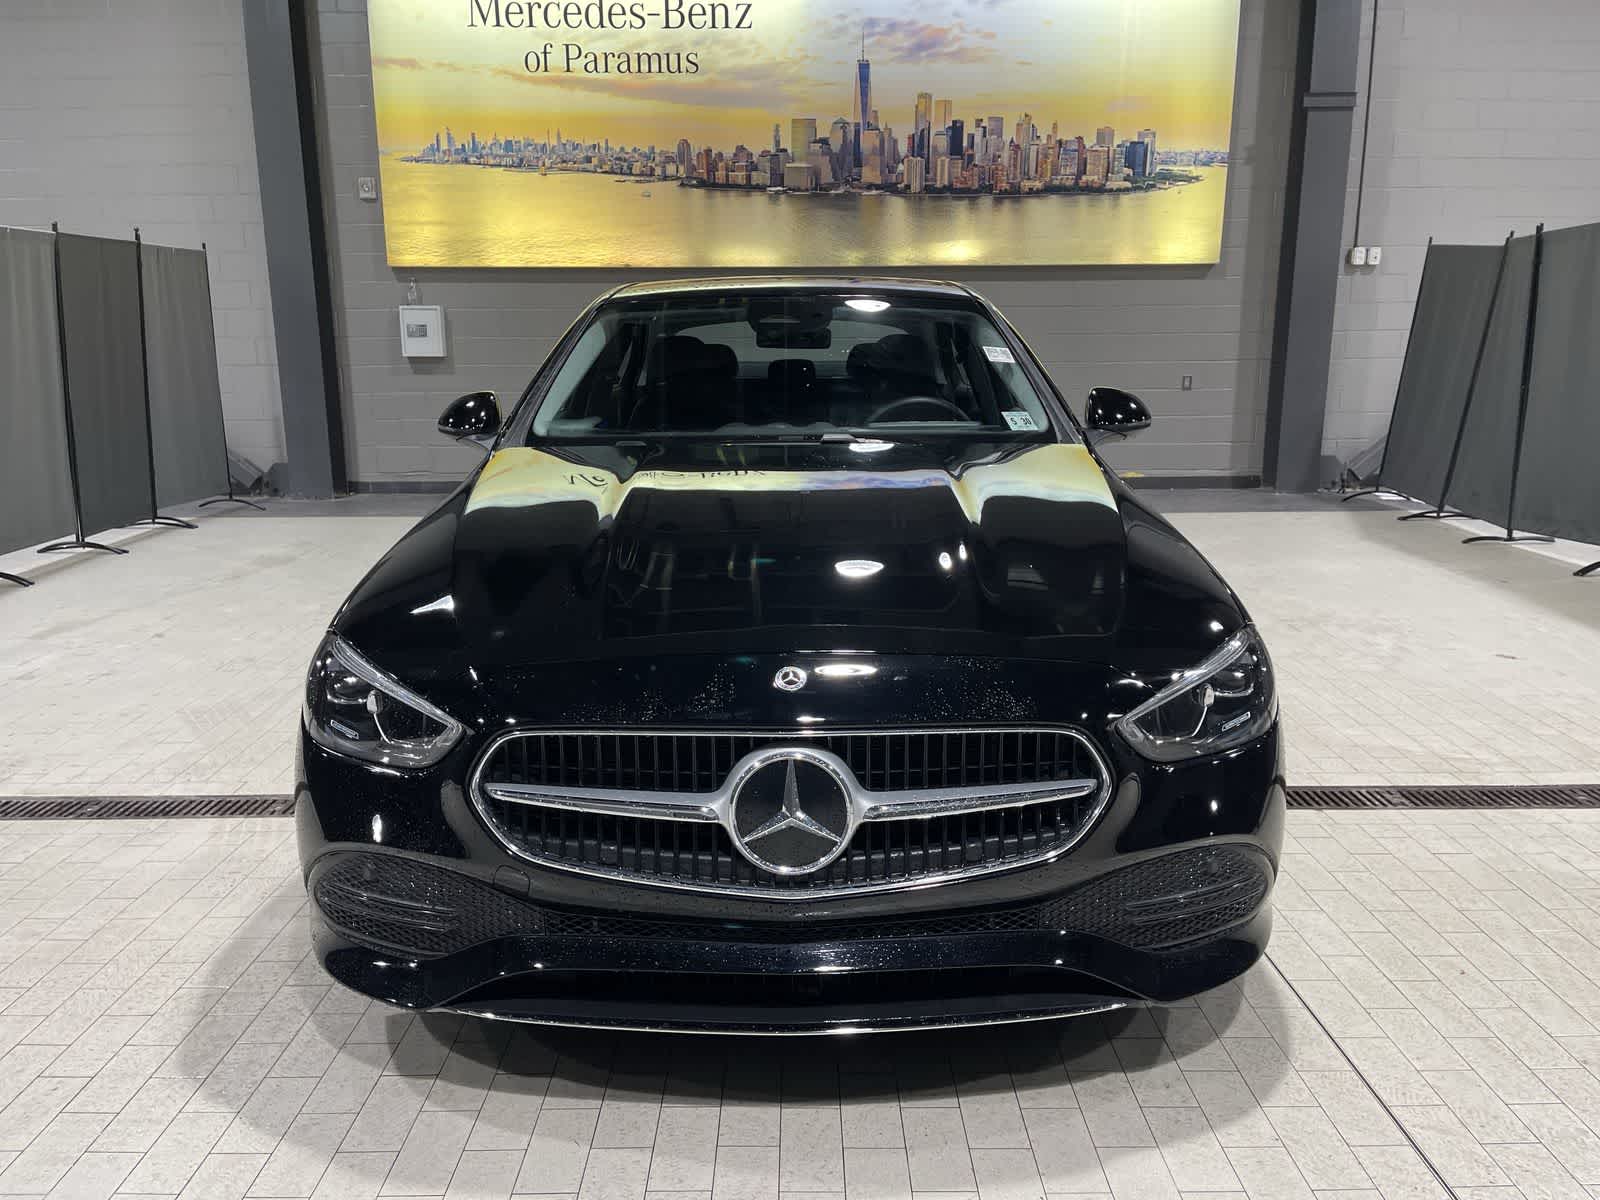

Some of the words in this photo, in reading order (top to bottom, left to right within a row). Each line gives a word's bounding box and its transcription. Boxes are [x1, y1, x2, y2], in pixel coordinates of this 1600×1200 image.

[467, 0, 753, 29] Mercedes-Benz
[524, 43, 553, 73] of
[562, 43, 699, 74] Paramus
